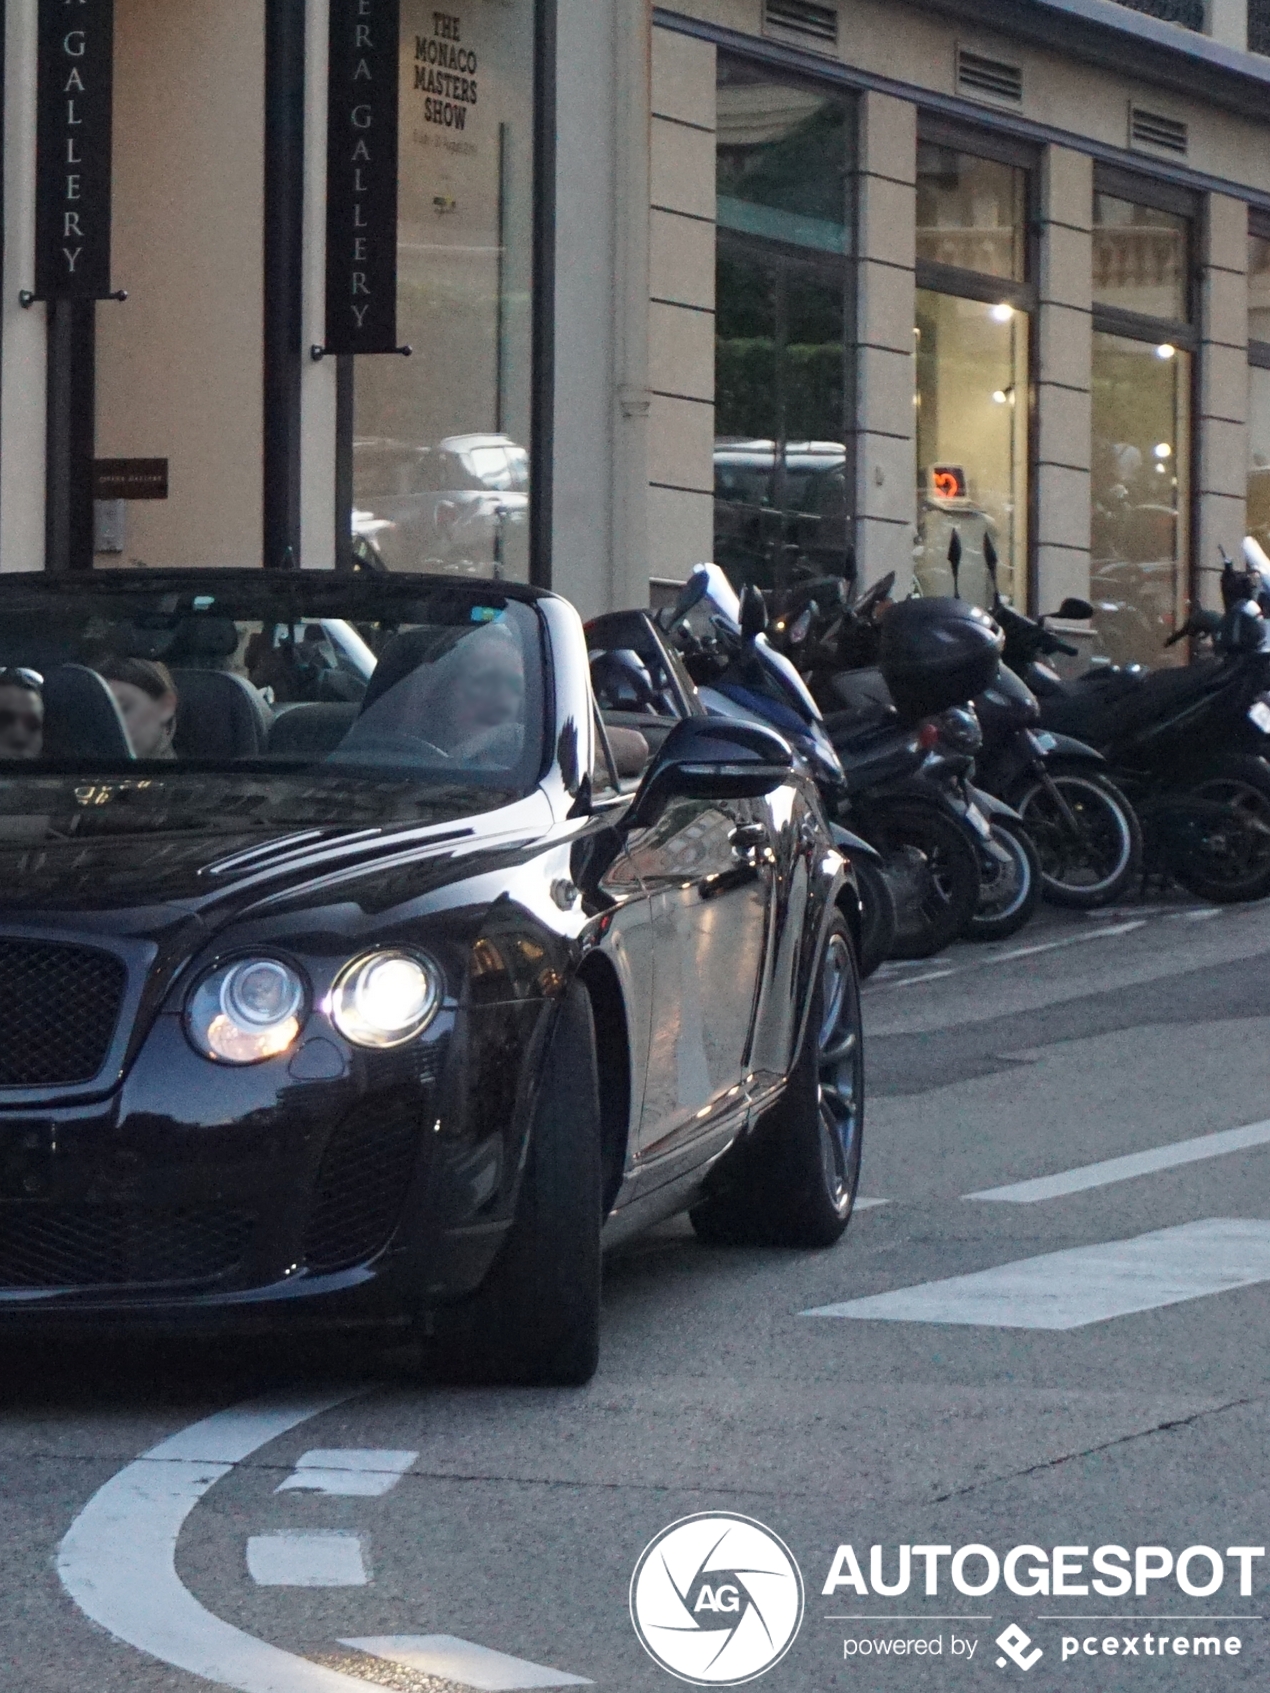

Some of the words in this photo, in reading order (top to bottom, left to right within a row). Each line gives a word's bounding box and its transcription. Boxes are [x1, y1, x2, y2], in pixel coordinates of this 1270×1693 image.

[432, 11, 461, 42] THE
[414, 35, 478, 75] MONACO
[414, 64, 478, 105] MASTERS
[424, 96, 467, 131] SHOW
[63, 31, 86, 273] GALLERY
[350, 105, 372, 328] GALLERY
